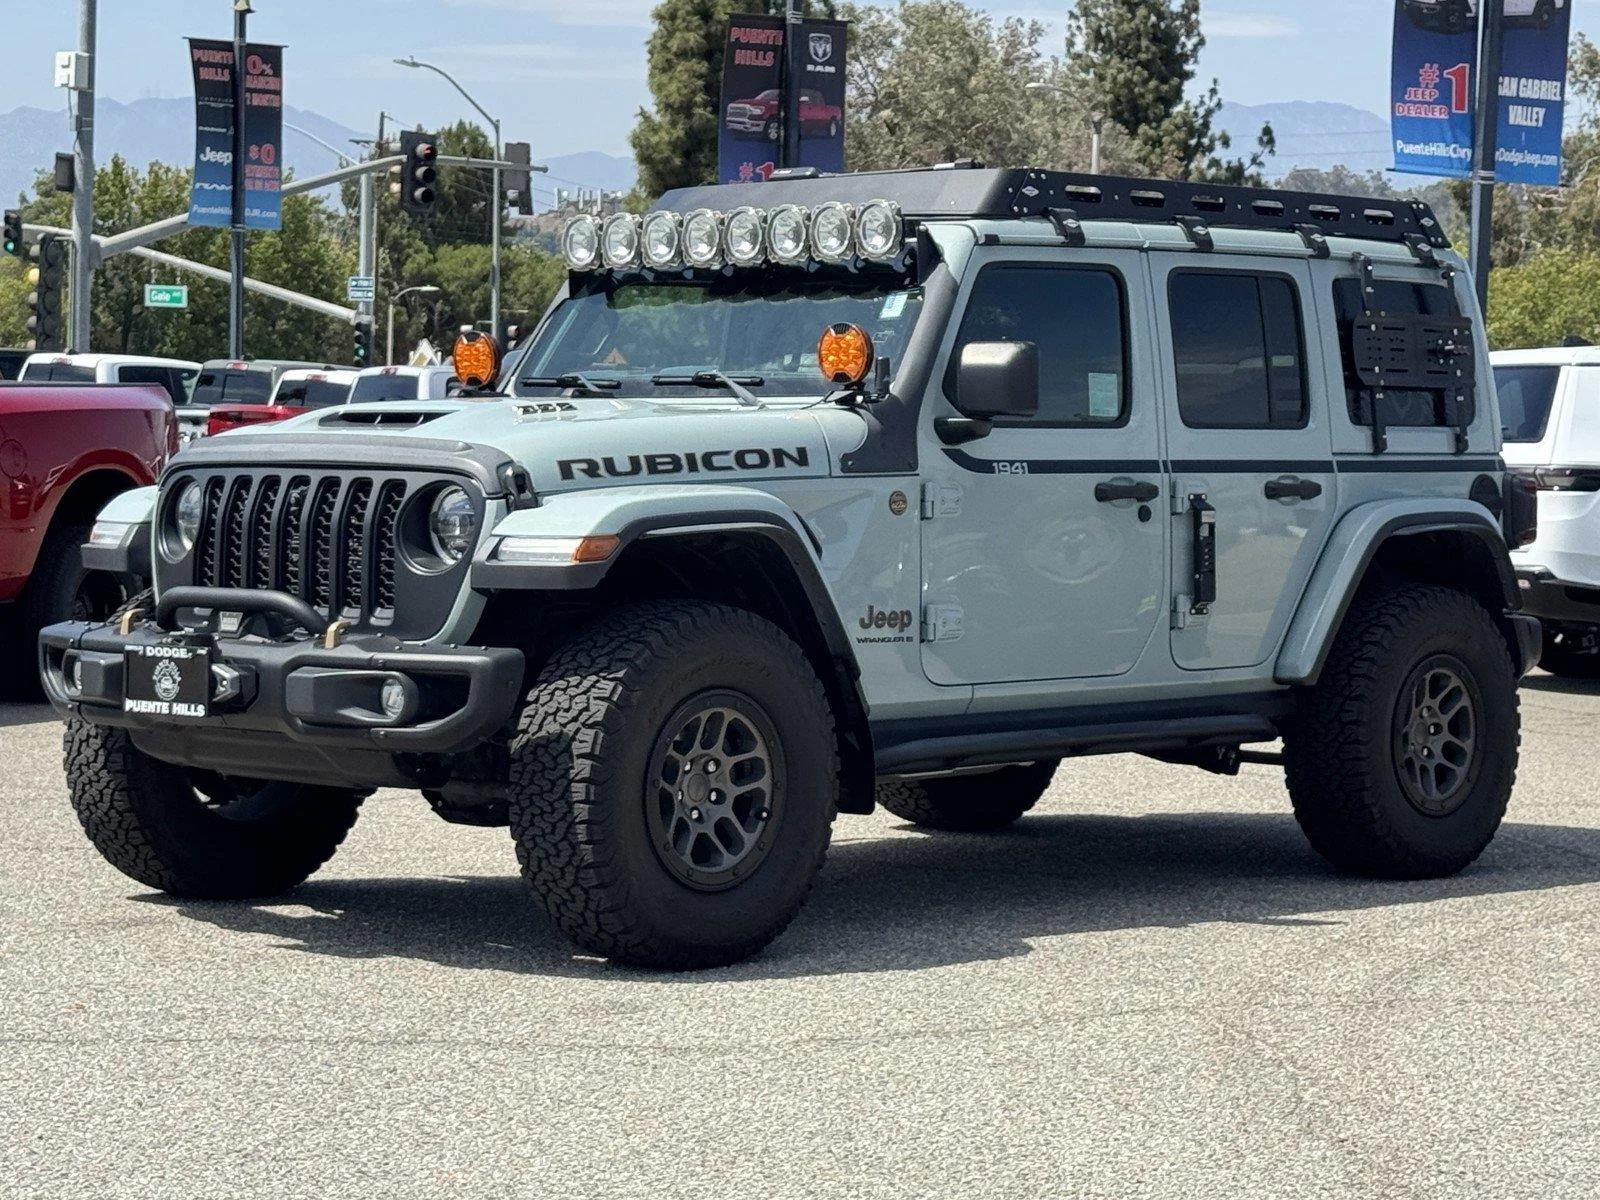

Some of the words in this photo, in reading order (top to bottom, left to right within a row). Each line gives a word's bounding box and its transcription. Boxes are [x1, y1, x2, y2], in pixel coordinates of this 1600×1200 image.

[730, 26, 783, 45] PUENTE
[734, 49, 775, 67] HILLS
[806, 64, 836, 74] RAM
[1404, 87, 1440, 102] JEEP
[1519, 77, 1562, 102] GABRIEL
[1395, 103, 1449, 119] DEALER
[1508, 104, 1546, 128] VALLEY
[199, 146, 233, 166] Jeep
[557, 446, 809, 481] RUBICON
[992, 461, 1029, 476] 1941
[859, 604, 913, 633] Jeep
[856, 636, 905, 644] WRANGLER
[124, 697, 170, 714] PUENTE
[171, 702, 206, 718] HILLS
